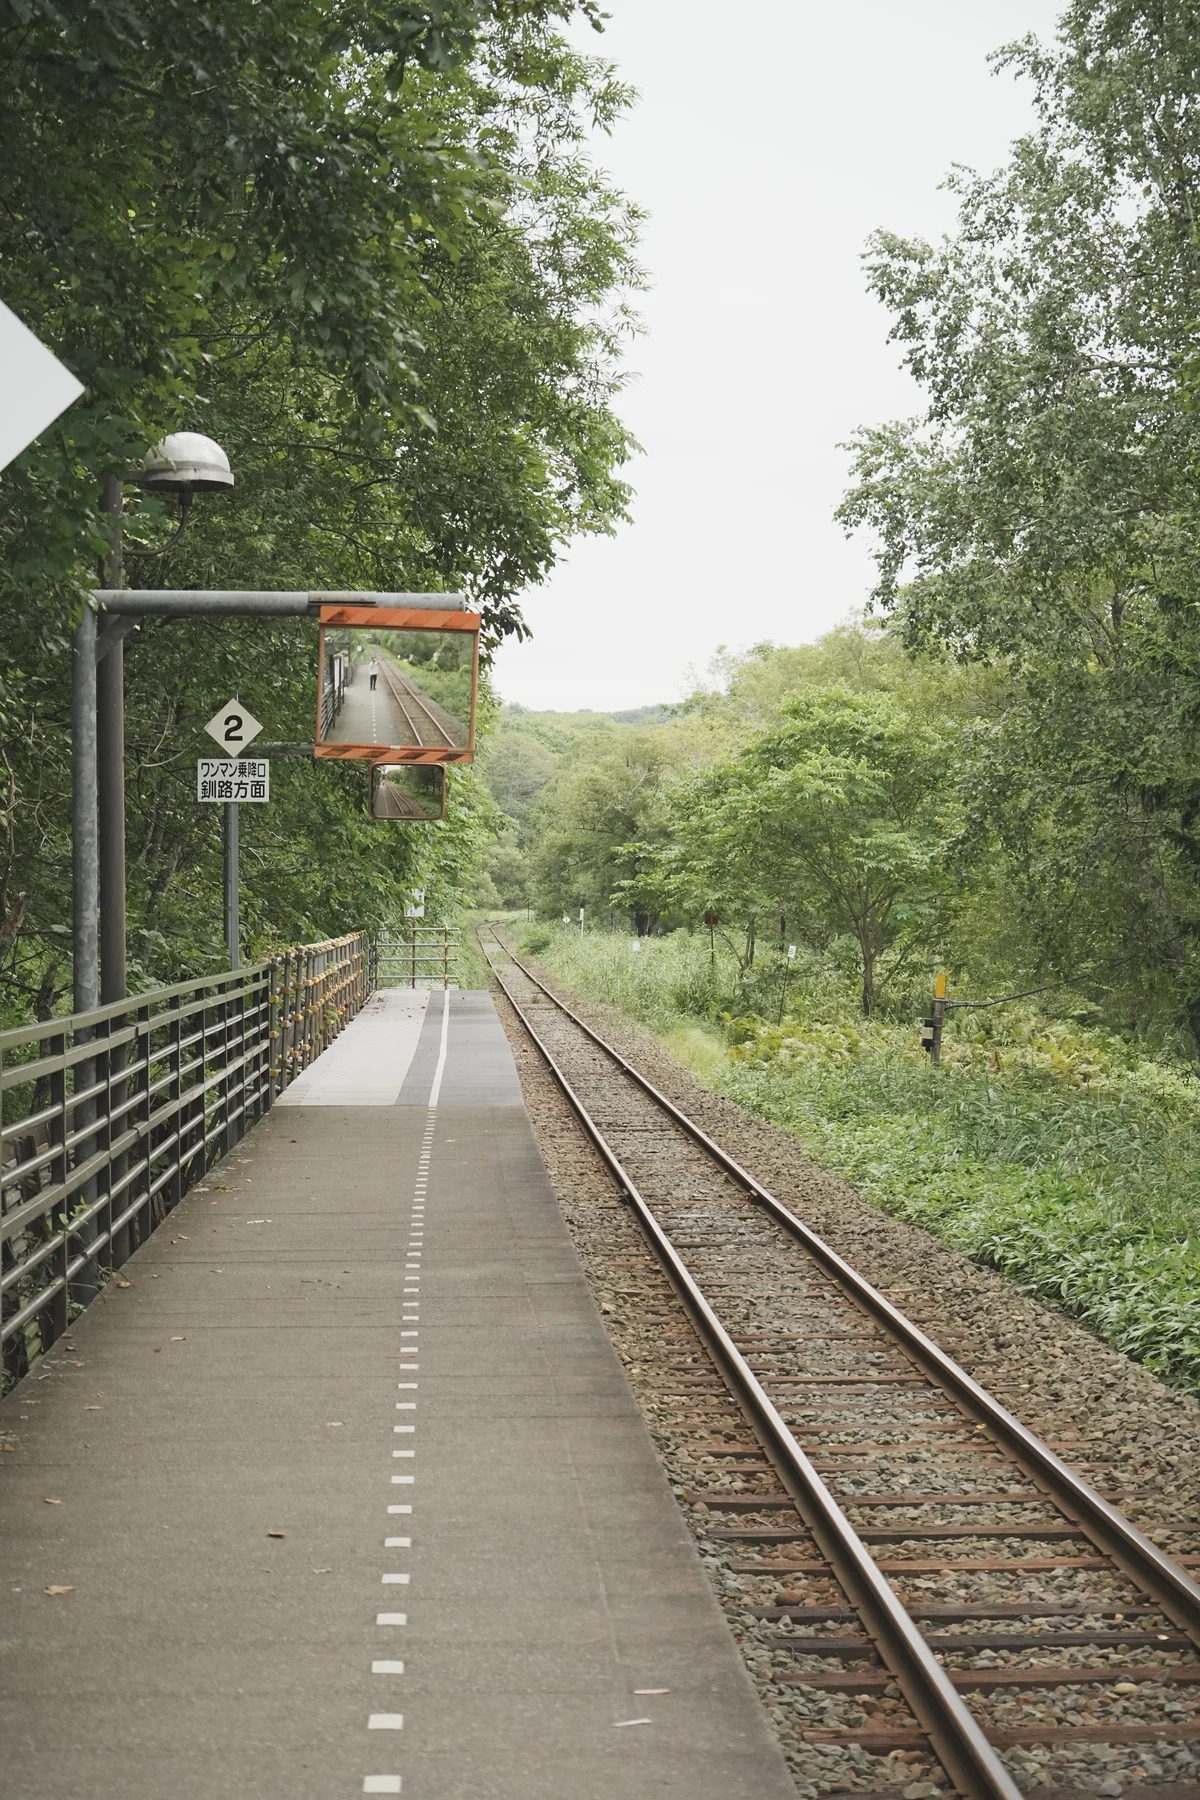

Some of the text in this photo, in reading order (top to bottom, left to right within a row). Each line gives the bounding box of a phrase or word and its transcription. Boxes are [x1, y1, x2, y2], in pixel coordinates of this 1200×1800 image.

[224, 715, 243, 741] 2
[201, 762, 266, 778] ワンマン乗降口
[201, 780, 266, 799] 釧路方面
